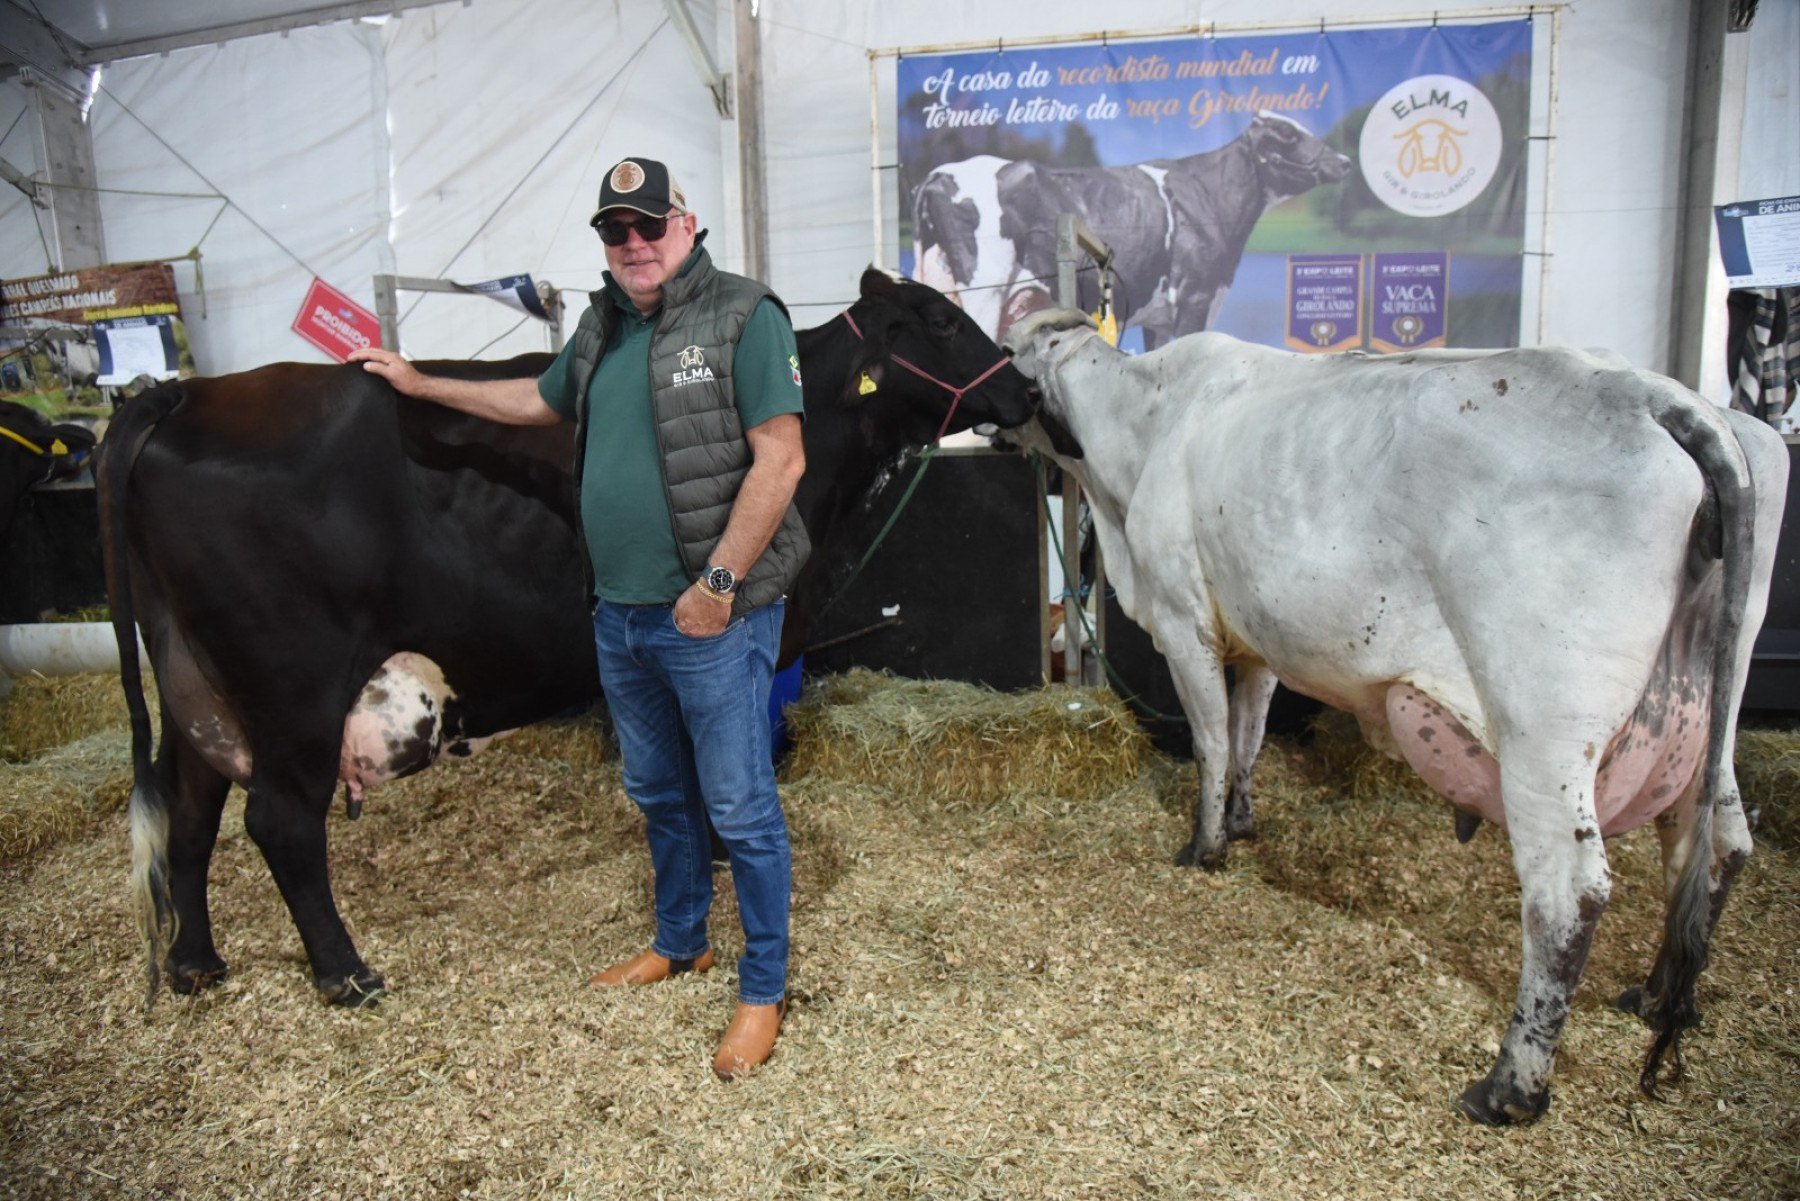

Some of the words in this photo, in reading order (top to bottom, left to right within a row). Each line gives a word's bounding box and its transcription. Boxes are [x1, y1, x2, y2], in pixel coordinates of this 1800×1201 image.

[923, 67, 955, 106] A
[958, 71, 1013, 92] casa
[1016, 61, 1052, 89] da
[1057, 54, 1171, 86] recordista
[1175, 47, 1280, 79] mundial
[1281, 54, 1321, 75] em
[922, 102, 1003, 129] torneio
[1005, 96, 1082, 124] leiteiro
[1085, 93, 1121, 120] da
[1126, 97, 1181, 125] raça
[1188, 81, 1330, 130] Girolando!
[1391, 89, 1469, 120] ELMA
[1759, 206, 1774, 215] DE
[1385, 284, 1436, 300] VACA
[1382, 300, 1437, 313] SUPREMA
[314, 305, 370, 348] PROIBIDO
[673, 367, 713, 382] ELMA
